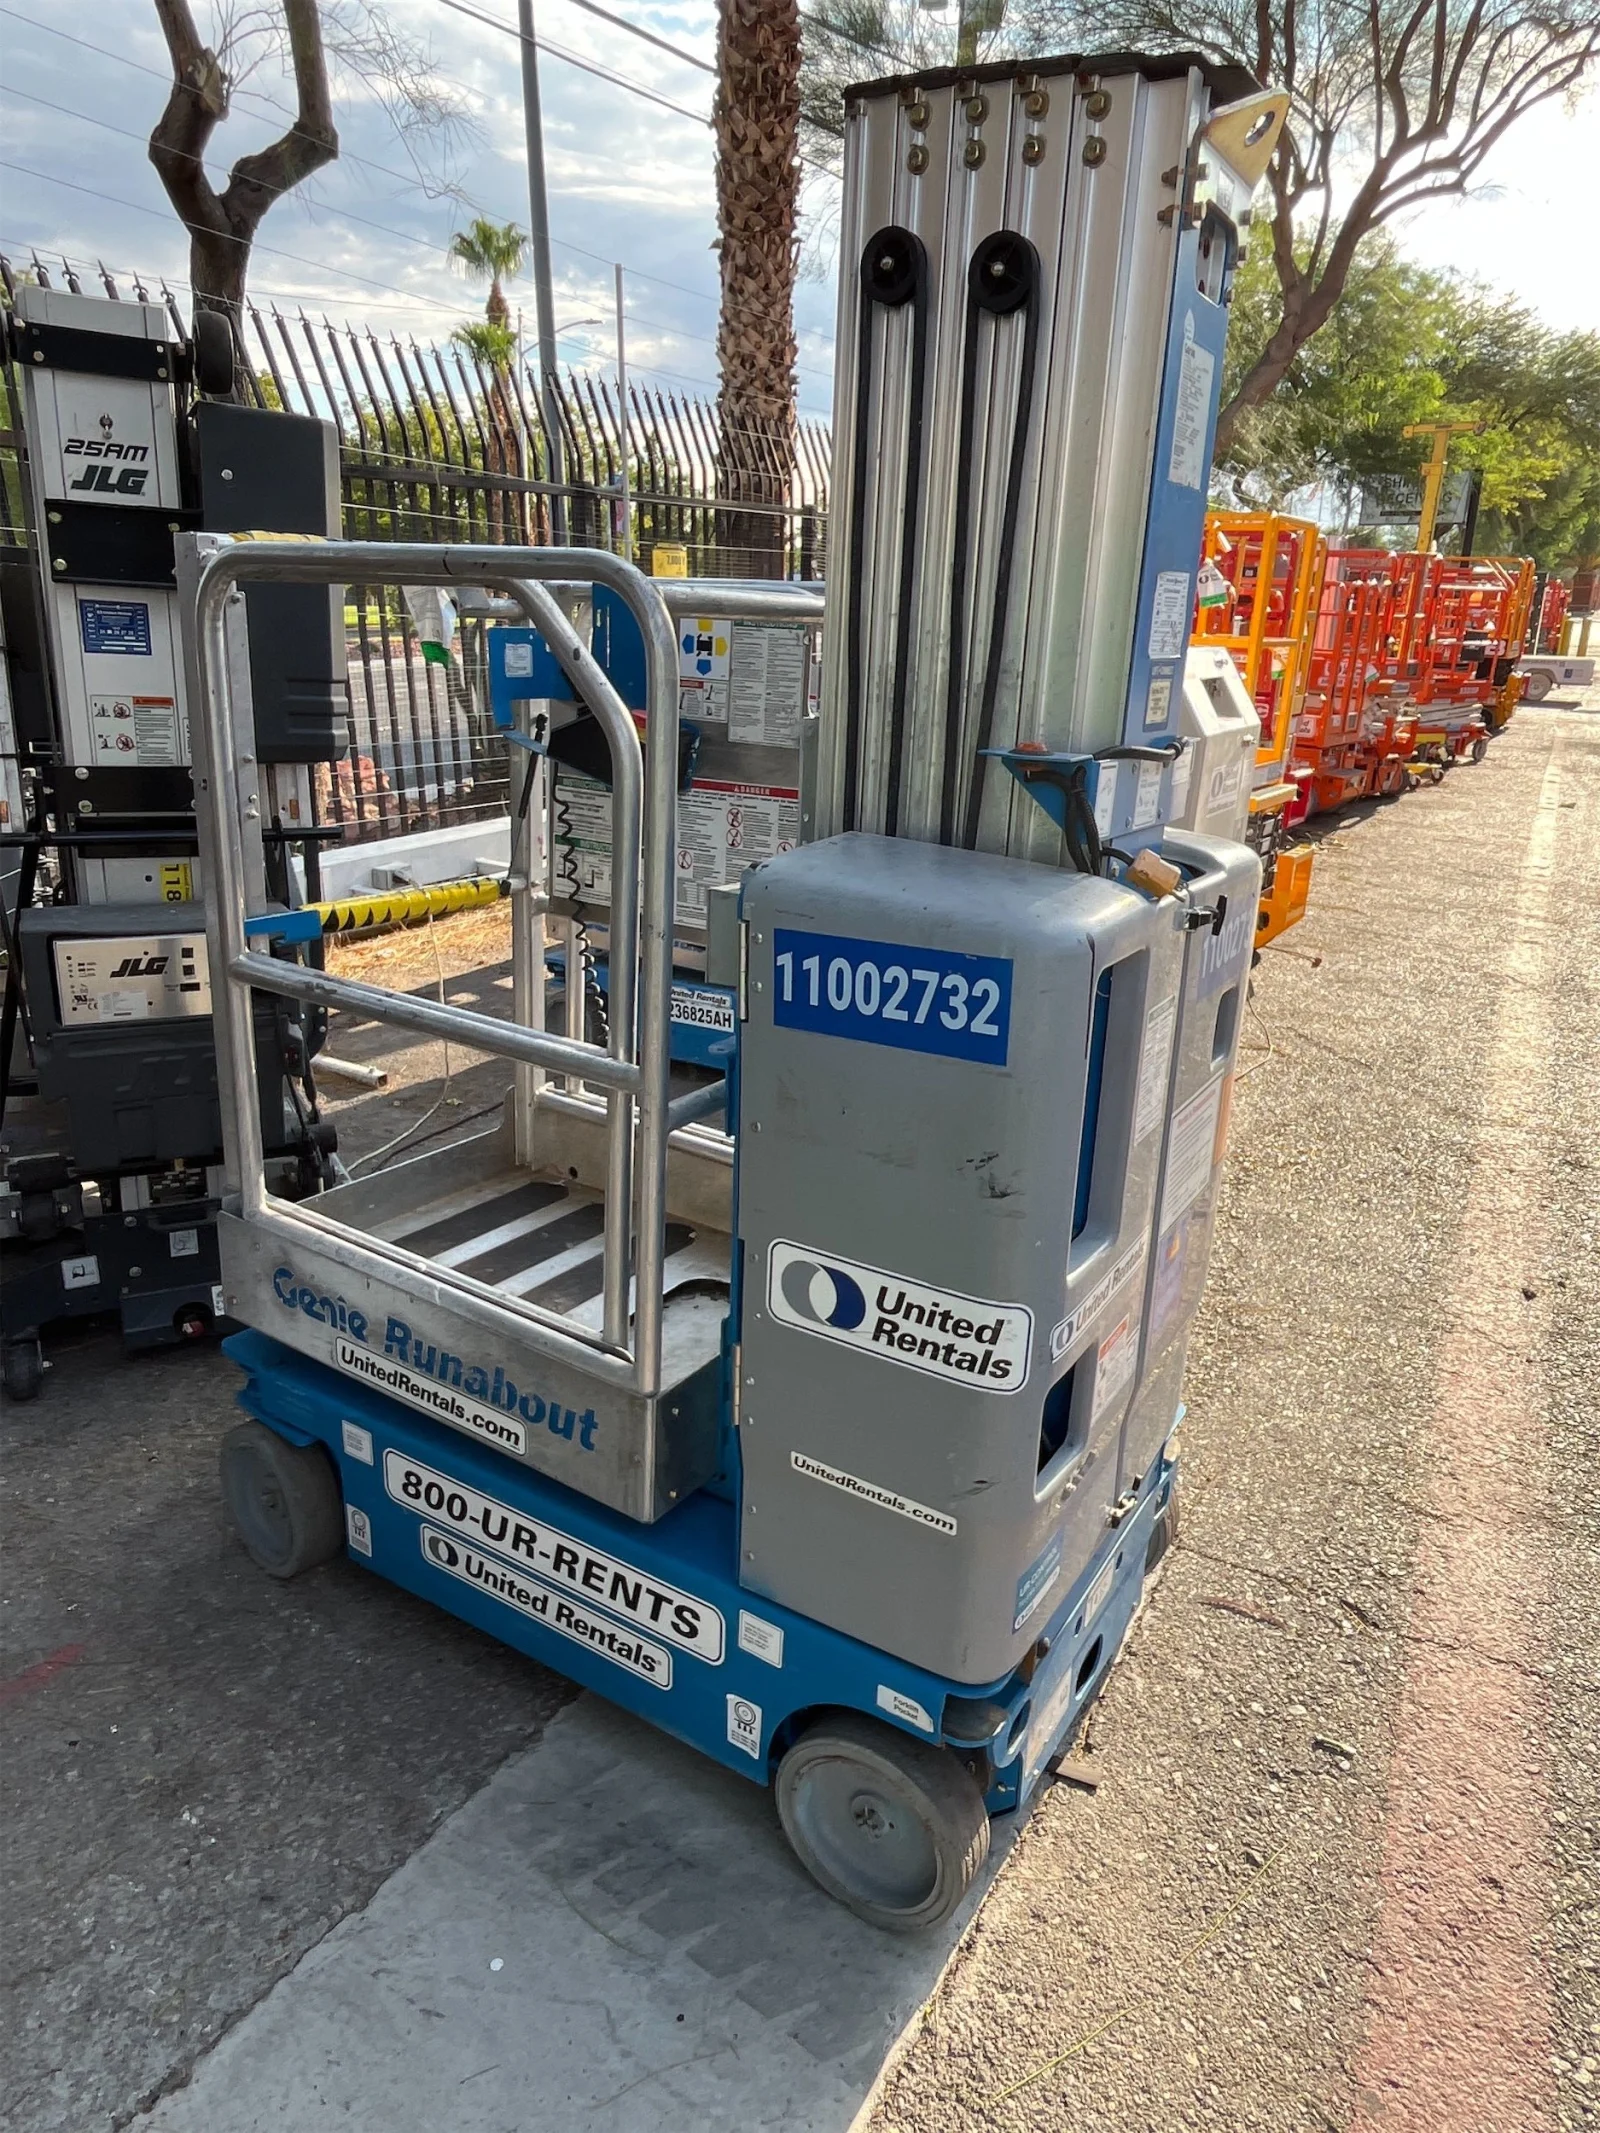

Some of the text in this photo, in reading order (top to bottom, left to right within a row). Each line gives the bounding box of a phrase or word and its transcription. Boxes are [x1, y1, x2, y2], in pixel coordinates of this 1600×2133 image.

[64, 438, 149, 462] 25AM
[71, 465, 149, 495] JLG
[740, 785, 770, 796] DANGER
[165, 864, 182, 902] 118
[110, 956, 169, 979] JLG
[696, 991, 728, 1005] Rentals
[776, 951, 1001, 1037] 11002732
[875, 1285, 1005, 1346] United
[1076, 1277, 1111, 1331] United
[1111, 1240, 1145, 1290] Rentals
[273, 1267, 599, 1451] Genie Runabout
[871, 1316, 1013, 1380] Rentals
[341, 1345, 521, 1446] UnitedRentals.com
[793, 1455, 955, 1532] UnitedRentals.com
[401, 1469, 701, 1640] 800-UR-RENTS
[464, 1554, 658, 1675] United Rentals
[893, 1696, 919, 1714] Forklift
[893, 1704, 918, 1721] Pocket
